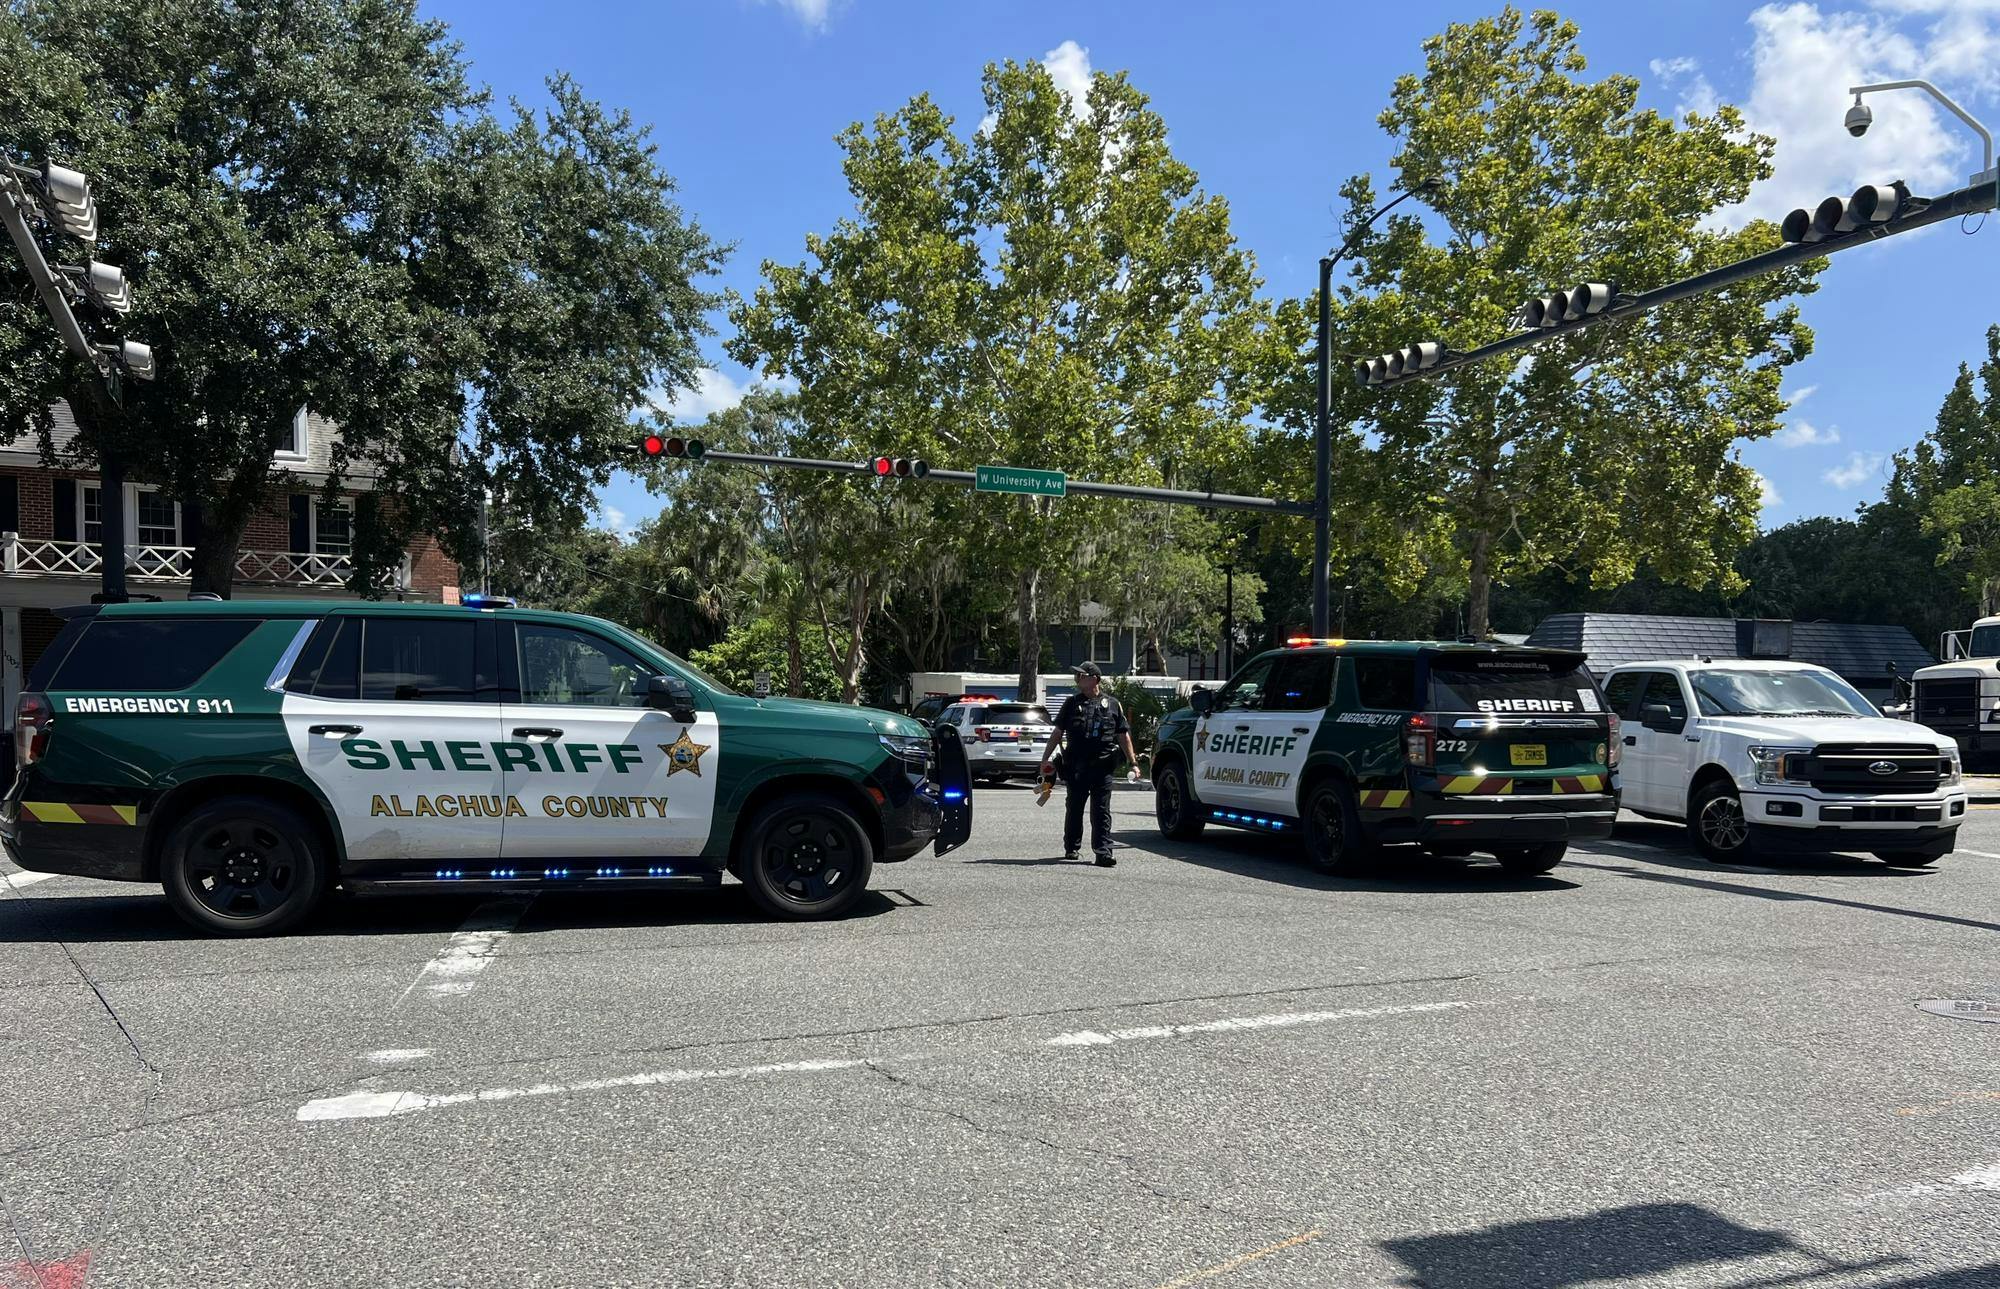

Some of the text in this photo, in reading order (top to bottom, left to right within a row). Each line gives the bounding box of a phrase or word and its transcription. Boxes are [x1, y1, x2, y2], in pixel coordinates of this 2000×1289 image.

[980, 473, 1062, 490] W University Ave
[756, 683, 768, 691] 25
[65, 697, 234, 714] EMERGENCY 911
[1476, 698, 1575, 713] SHERIFF
[1335, 712, 1402, 725] EMERGENCY 911
[1210, 733, 1298, 757] SHERIFF
[1436, 739, 1468, 753] 272
[340, 738, 644, 774] SHERIFF
[1204, 765, 1291, 787] ALACHUA COUNTY
[370, 794, 669, 818] ALACHUA COUNTY
